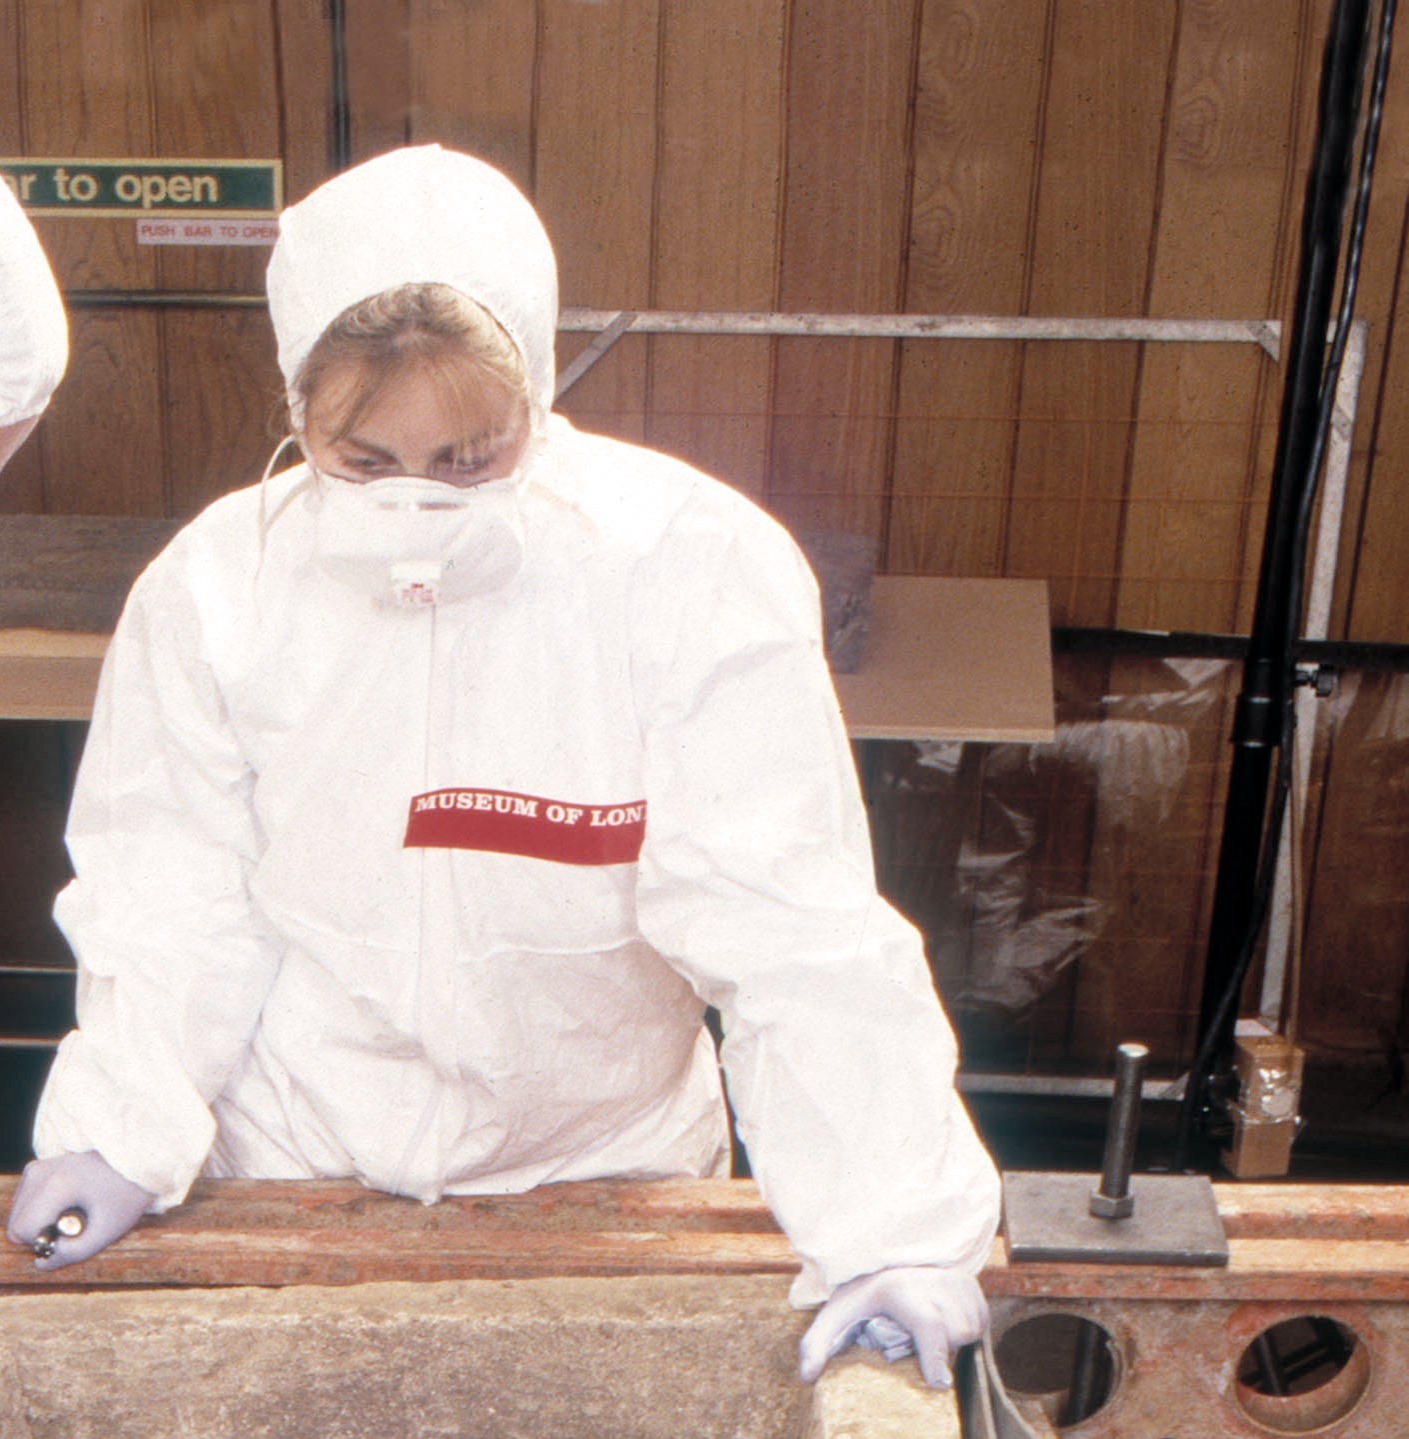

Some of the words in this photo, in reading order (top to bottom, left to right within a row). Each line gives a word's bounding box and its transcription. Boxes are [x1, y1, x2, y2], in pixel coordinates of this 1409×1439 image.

[53, 167, 98, 201] to
[115, 174, 219, 209] open
[141, 225, 176, 237] PUSH
[184, 225, 212, 237] BAR
[220, 225, 238, 238] TO
[242, 225, 279, 239] OPEN
[415, 792, 538, 818] MUSEUM
[546, 804, 583, 826] OF
[589, 803, 647, 827] LON
